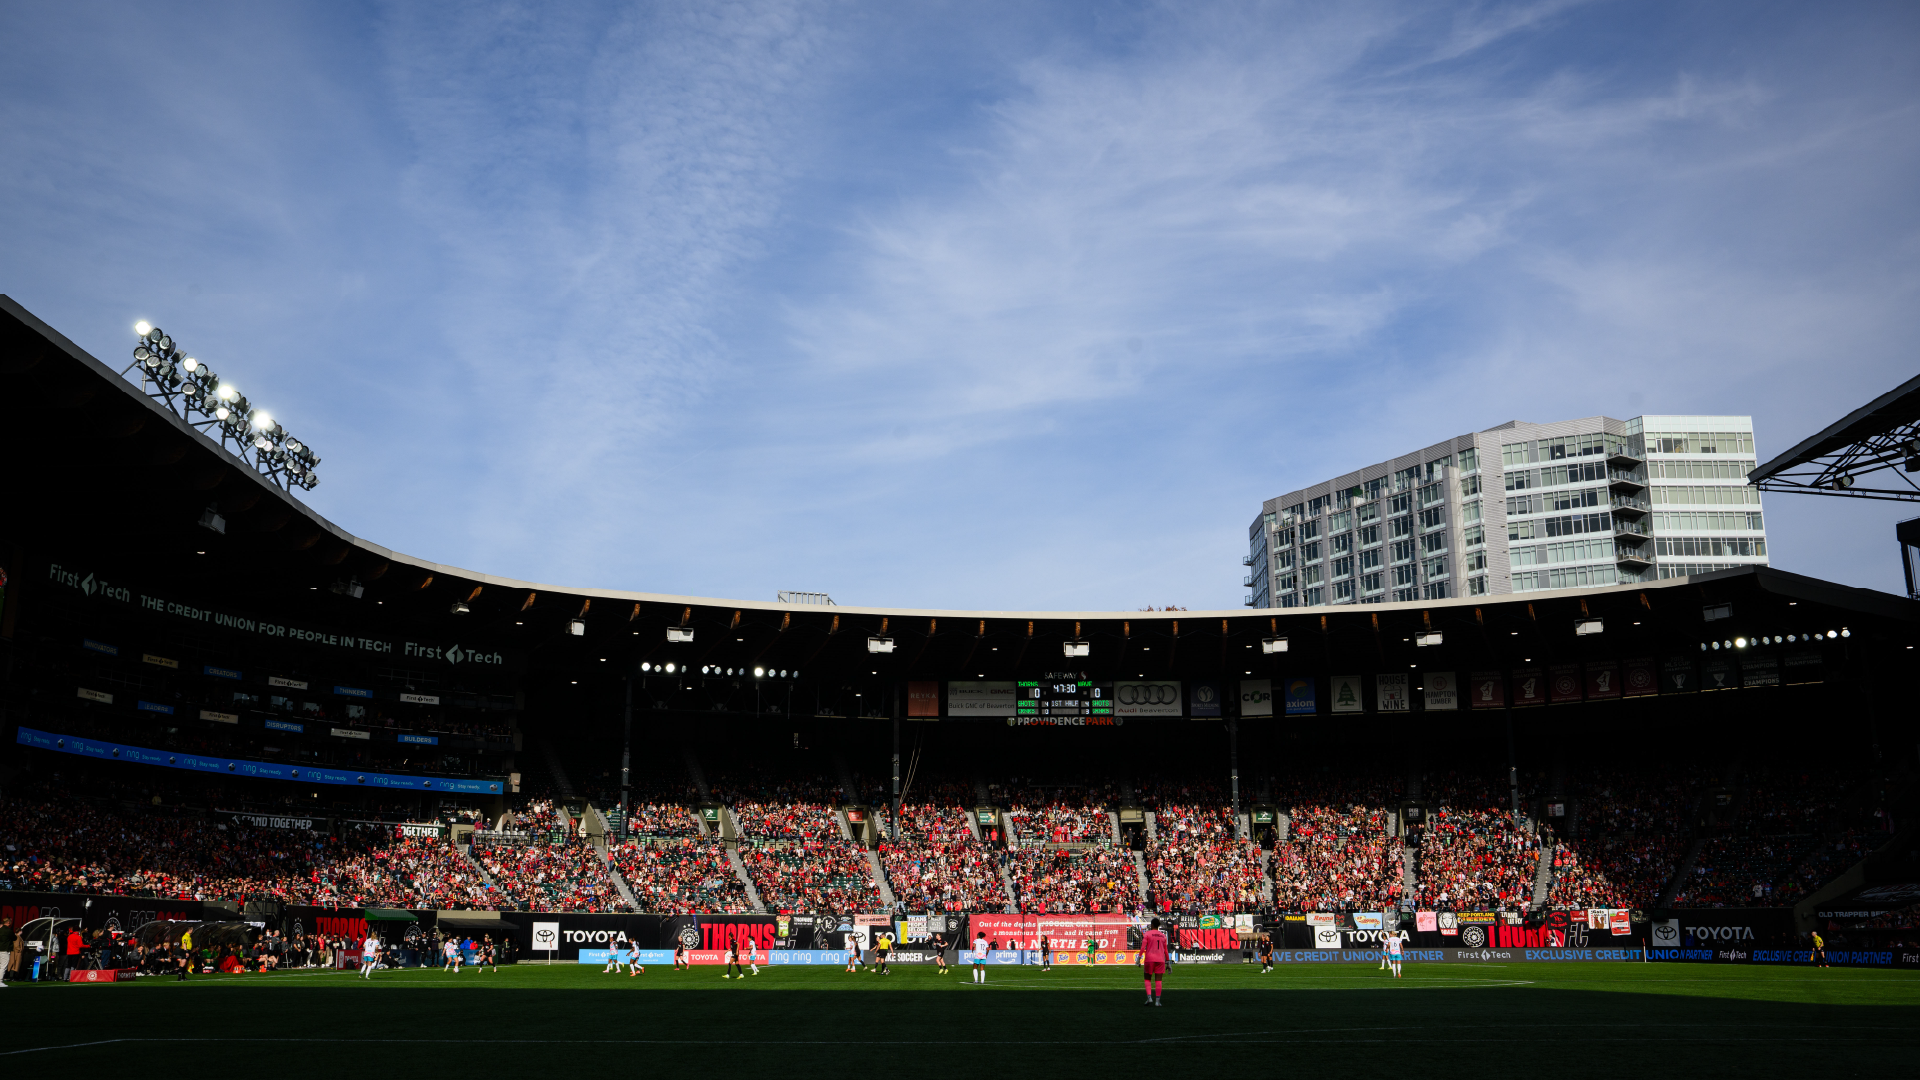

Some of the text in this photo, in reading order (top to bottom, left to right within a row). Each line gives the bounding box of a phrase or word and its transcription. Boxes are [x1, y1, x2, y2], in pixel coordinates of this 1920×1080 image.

[49, 563, 131, 604] First Tech
[140, 594, 393, 655] THE CREDIT UNION FOR PEOPLE IN TECH
[84, 640, 118, 656] INNOVATORS
[404, 640, 504, 666] First Tech
[208, 667, 238, 679] CREATORS
[1044, 671, 1078, 680] SAFEWAY
[1378, 675, 1406, 688] HOUSE
[1034, 688, 1101, 699] 0 0
[1053, 684, 1077, 694] 47:30
[1425, 691, 1456, 701] HAMPTON
[1286, 699, 1315, 709] axiom
[1382, 700, 1405, 710] WINE
[266, 720, 302, 732] DISRUPTORS
[403, 734, 432, 744] BUILDERS
[72, 740, 84, 753] ring
[126, 750, 140, 764] ring
[184, 758, 197, 772] ring
[243, 764, 257, 779] ring
[308, 771, 322, 783] ring
[374, 777, 388, 788] ring
[440, 781, 455, 792] ring
[270, 817, 313, 830] TOGETHER
[401, 826, 440, 838] OGETHER
[1014, 921, 1036, 930] depths
[563, 930, 628, 943] TOYOTA
[1036, 929, 1054, 937] sound
[1684, 926, 1755, 940] TOYOTA
[1030, 939, 1078, 949] NRTH
[1081, 939, 1109, 949] ED
[691, 953, 719, 961] TOYOTA
[770, 951, 790, 965] ring
[793, 951, 812, 965] ring
[821, 951, 840, 965] ring
[898, 952, 923, 962] SOCCER
[996, 951, 1018, 960] prime
[1058, 954, 1069, 962] Tide
[1096, 954, 1106, 962] Tide
[1180, 951, 1223, 961] Nationwide
[1315, 951, 1383, 961] CREDIT UNION
[1457, 951, 1511, 959] First Tech
[1525, 949, 1713, 961] EXCLUSIVE CREDIT UNION PARTNER
[1719, 951, 1747, 960] First Tech
[1752, 950, 1894, 964] EXCLUSIVE PARTNER
[1902, 953, 1920, 963] First
